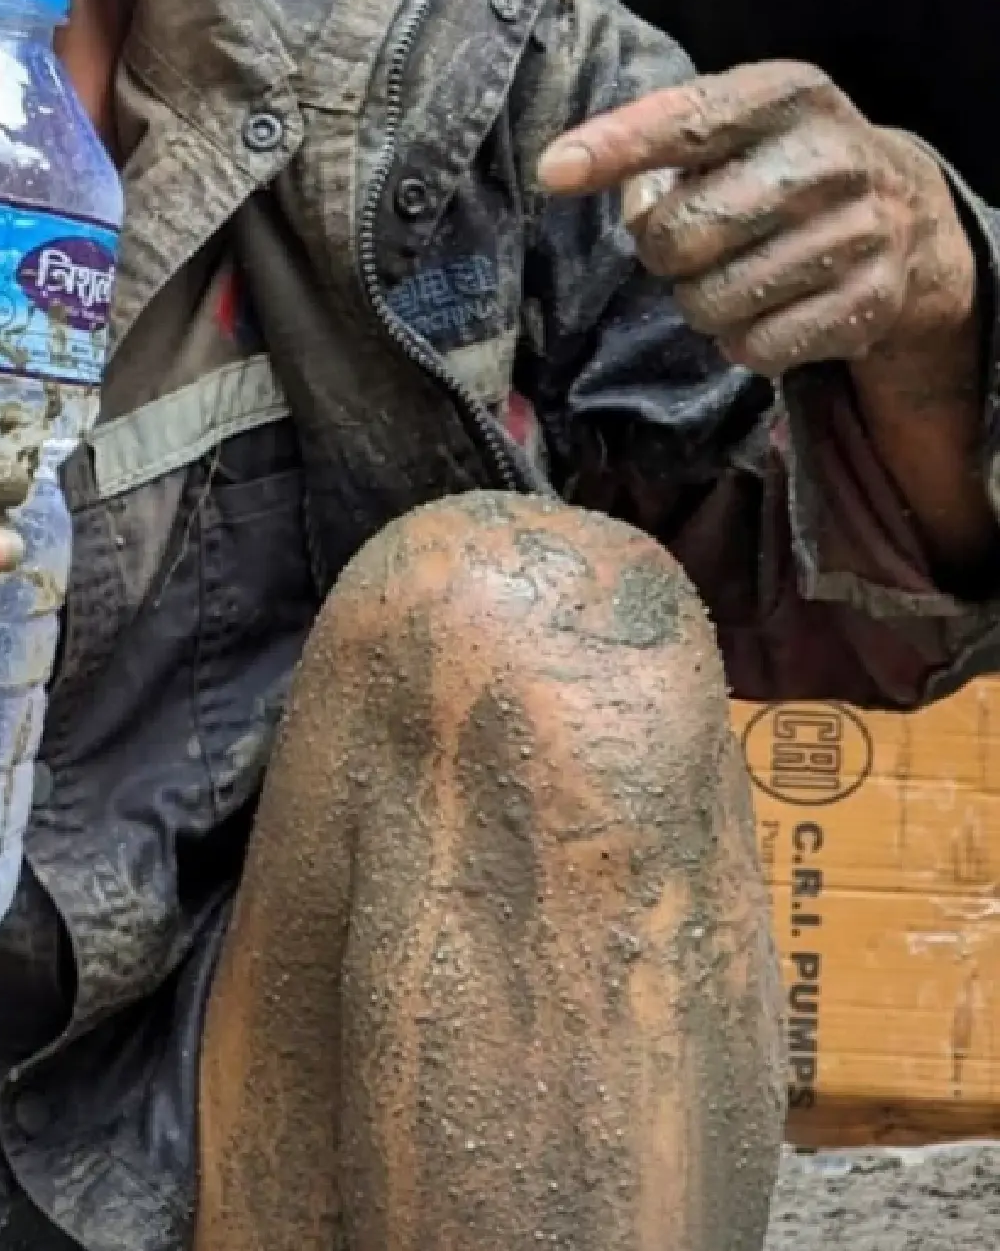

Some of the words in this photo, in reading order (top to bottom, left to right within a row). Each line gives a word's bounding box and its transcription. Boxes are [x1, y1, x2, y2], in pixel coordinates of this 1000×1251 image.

[771, 710, 843, 791] CRI
[789, 820, 823, 937] C.R.I.
[788, 953, 821, 1109] PUMPS
